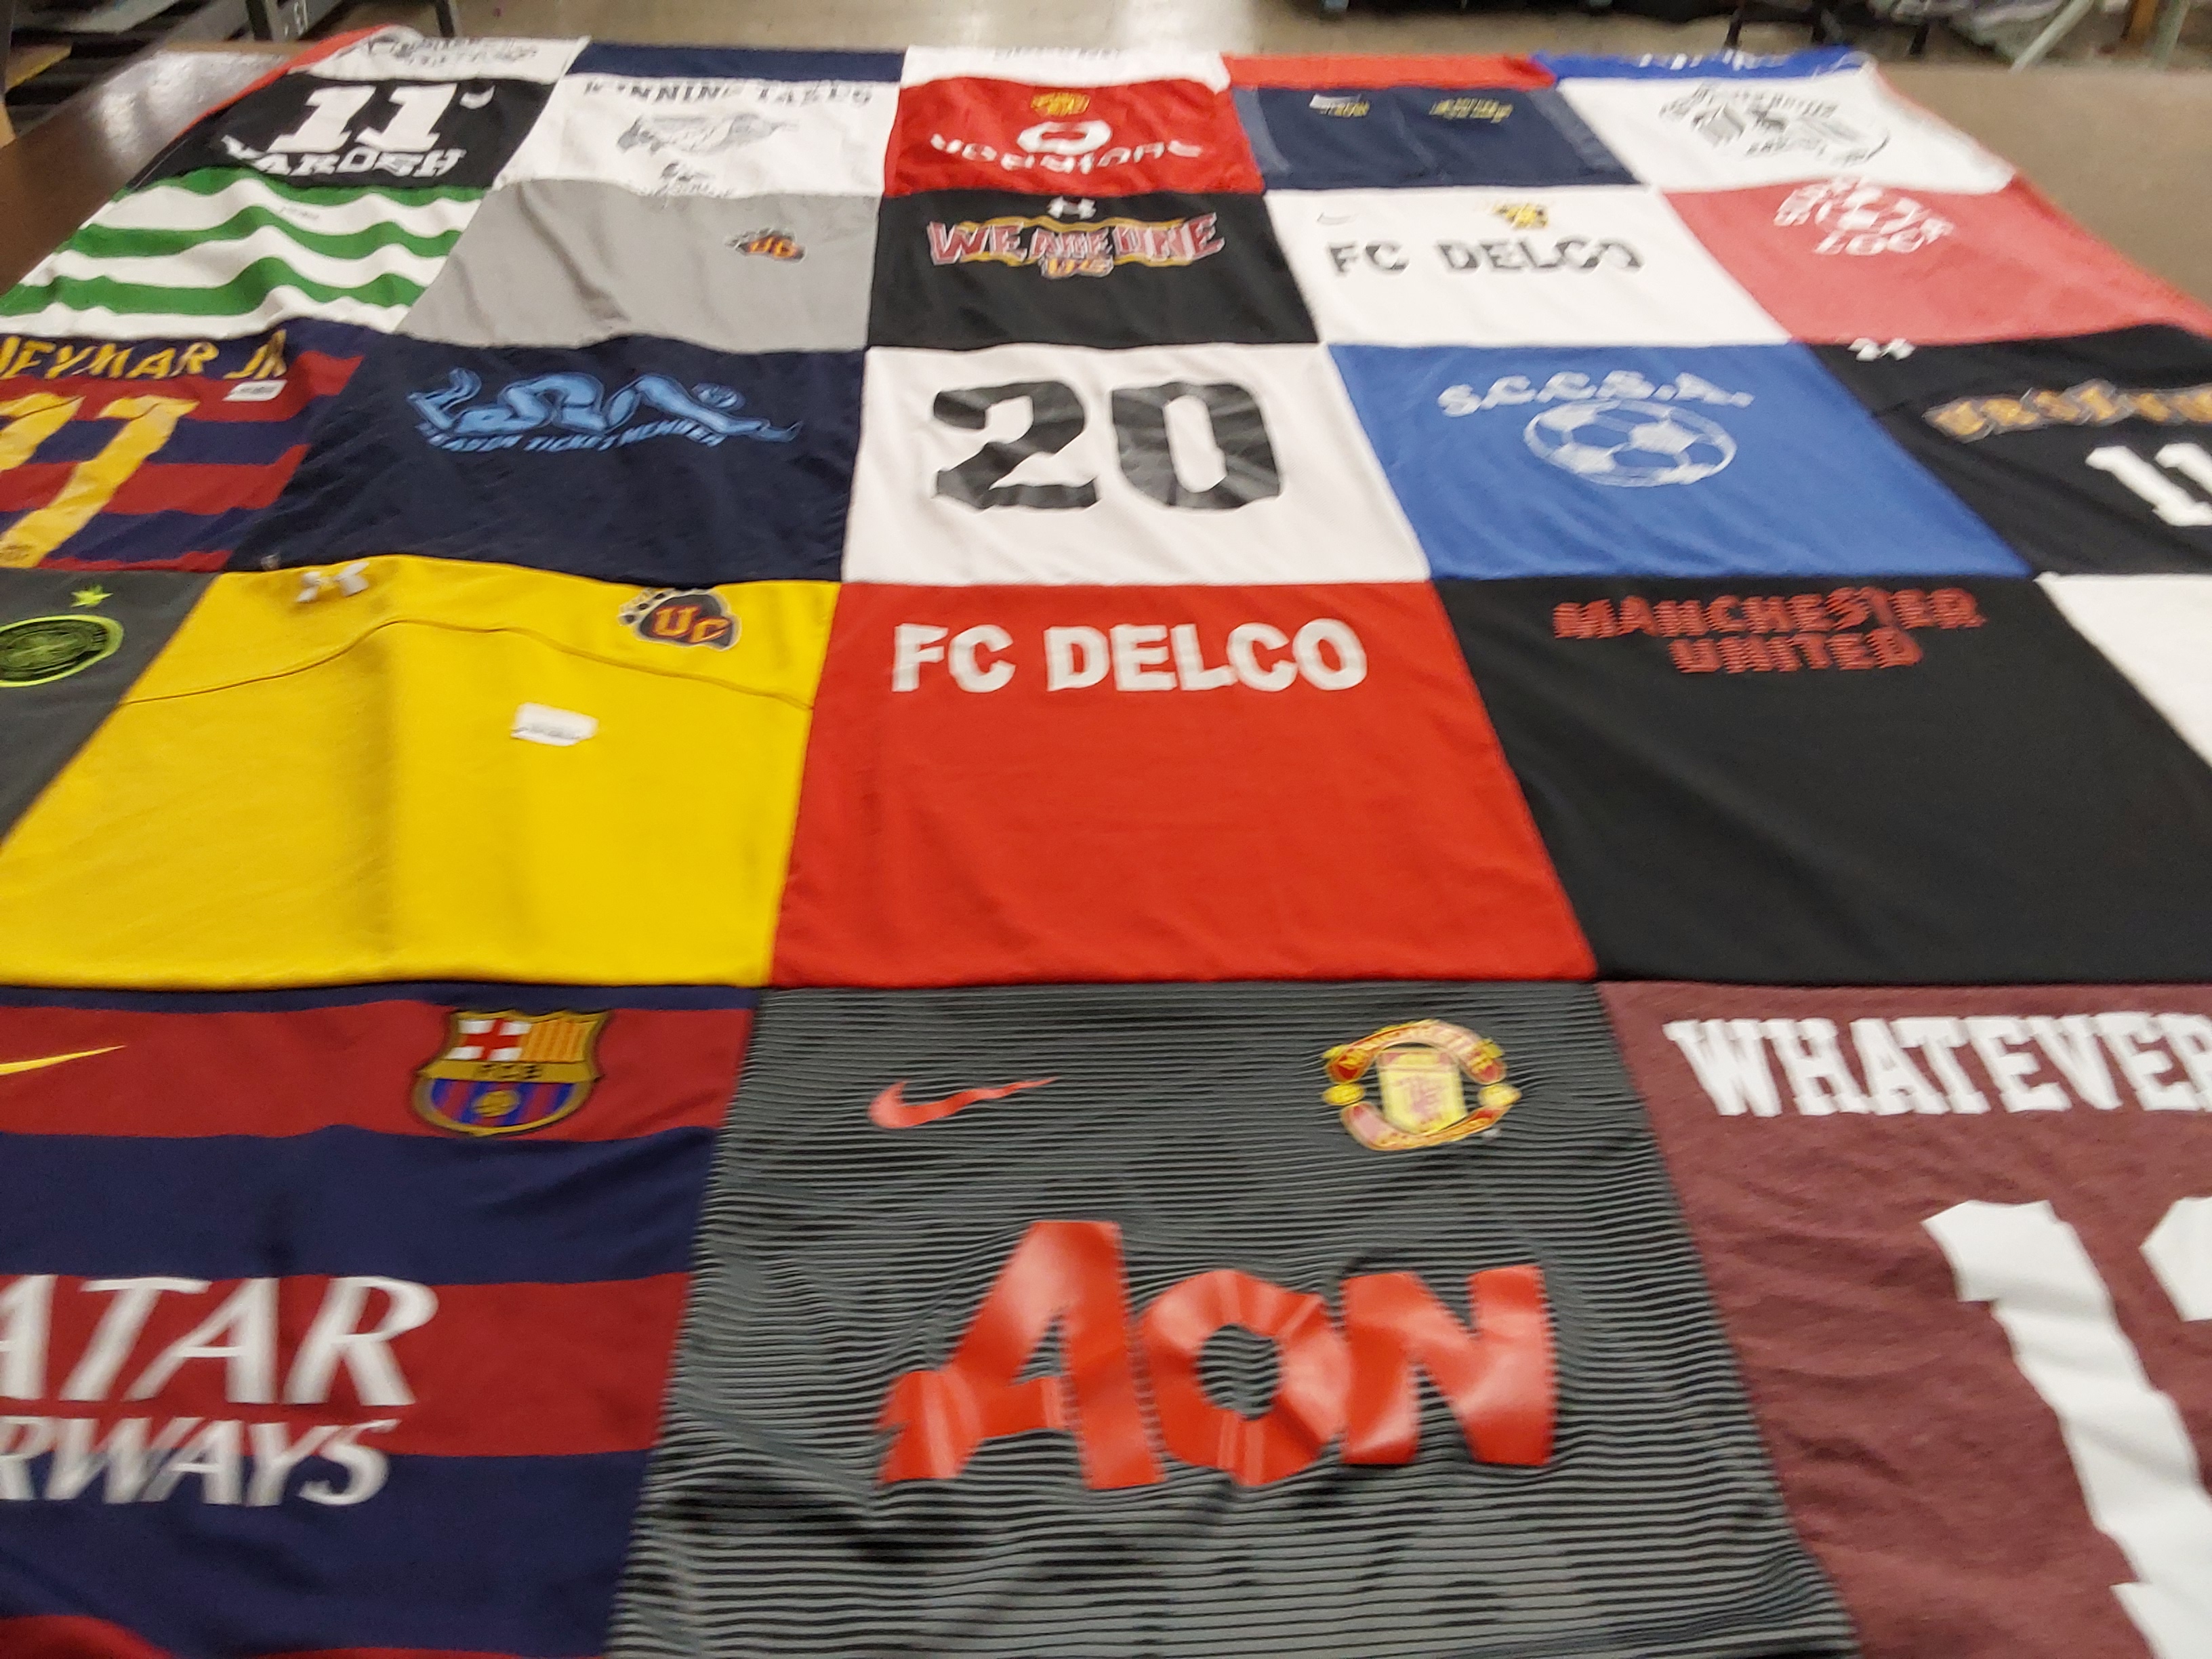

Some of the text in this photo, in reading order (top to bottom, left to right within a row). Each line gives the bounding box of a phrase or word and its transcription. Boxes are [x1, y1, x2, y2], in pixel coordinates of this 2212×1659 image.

[266, 84, 458, 153] 11
[1327, 237, 1647, 276] FC DELCO
[933, 380, 1282, 511] 20
[1553, 586, 1988, 638] MANCHESTER
[891, 617, 1368, 693] FC DELCO
[1666, 625, 1924, 674] UNITED
[874, 1219, 1557, 1490] AON
